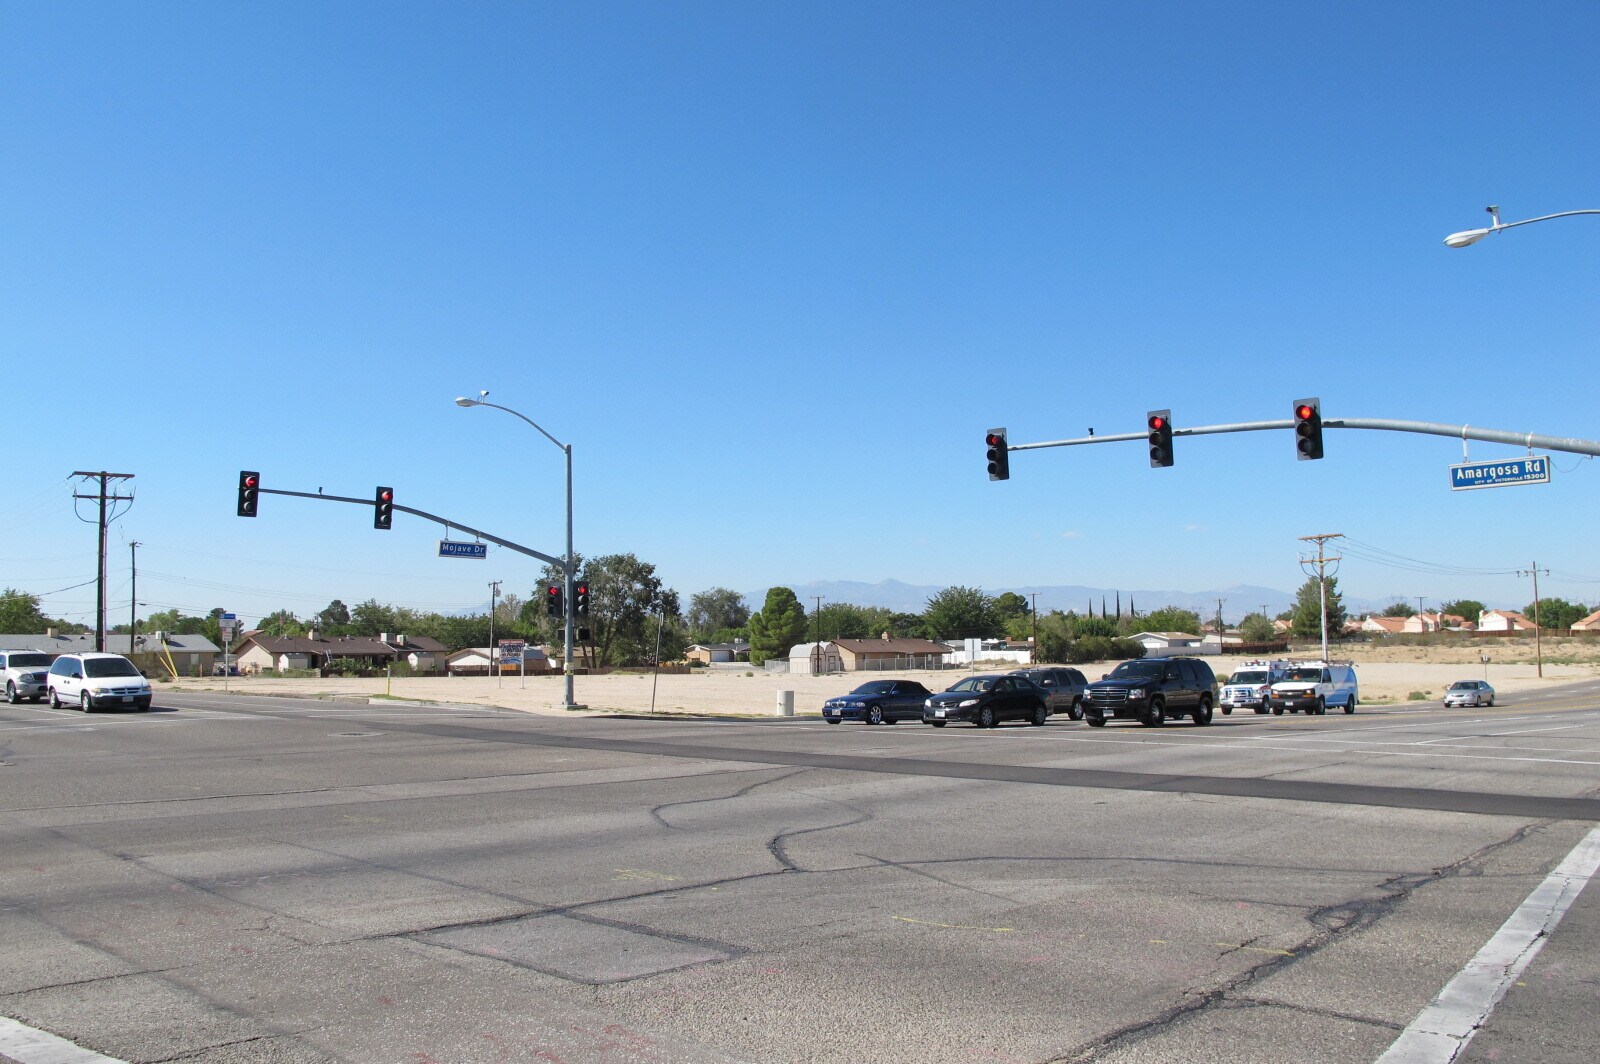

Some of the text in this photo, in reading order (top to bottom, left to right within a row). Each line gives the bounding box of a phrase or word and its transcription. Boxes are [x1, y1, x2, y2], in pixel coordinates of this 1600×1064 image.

[1457, 461, 1540, 479] Amargosa Rd
[442, 544, 471, 553] Mojave
